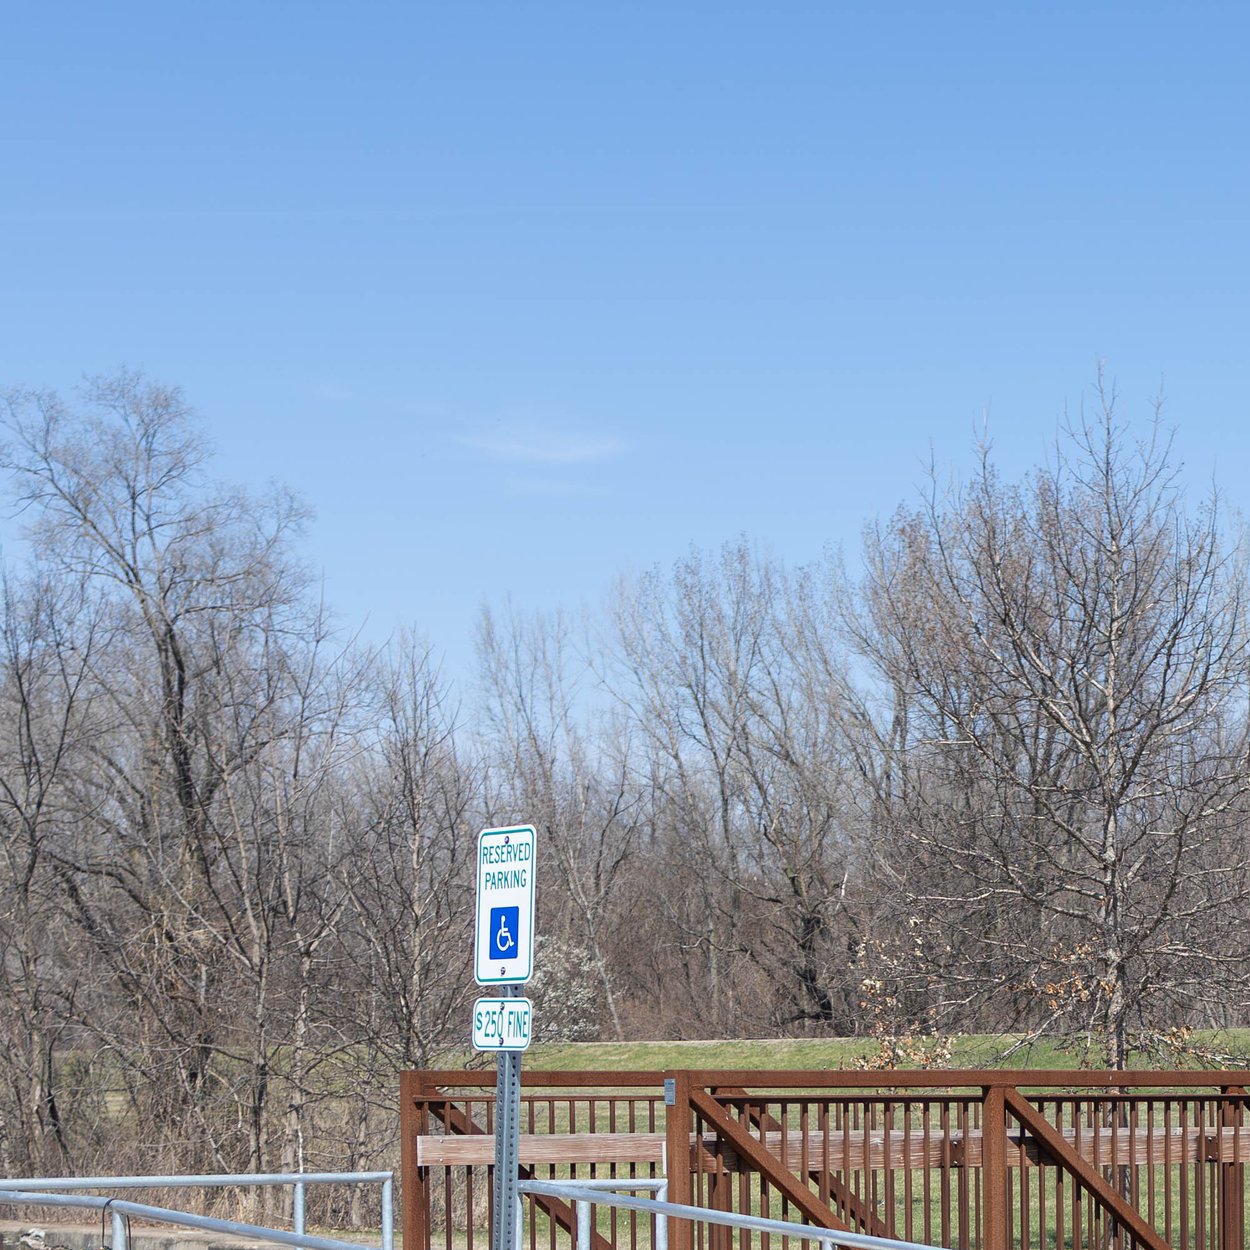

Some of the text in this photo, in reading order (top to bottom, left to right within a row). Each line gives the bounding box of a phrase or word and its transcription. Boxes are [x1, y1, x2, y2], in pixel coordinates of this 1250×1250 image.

[482, 842, 531, 864] RESERVED
[485, 869, 527, 890] PARKING
[476, 1010, 529, 1038] $250 FINE
